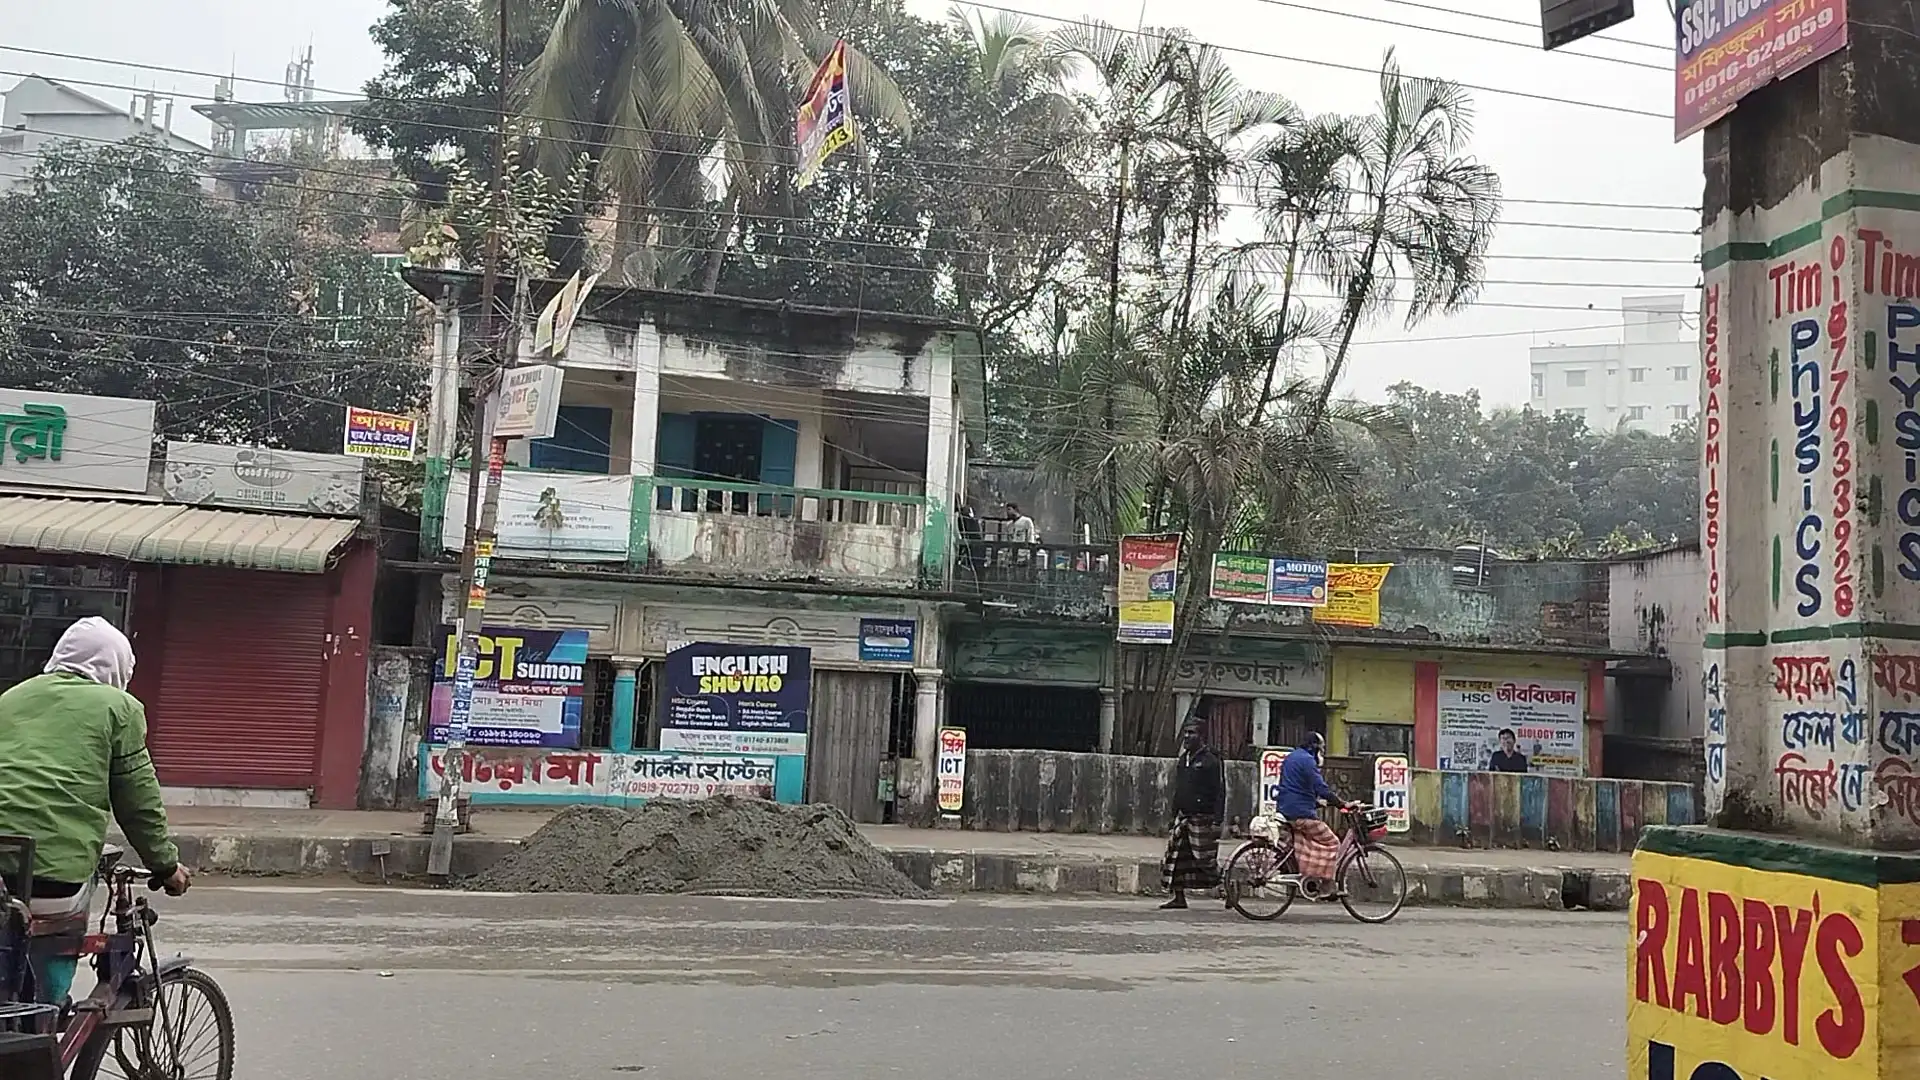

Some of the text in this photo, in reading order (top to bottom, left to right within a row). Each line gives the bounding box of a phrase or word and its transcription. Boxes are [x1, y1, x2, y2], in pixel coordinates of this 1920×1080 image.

[1684, 7, 1834, 105] 01916-624059
[1769, 260, 1822, 320] Tim
[512, 387, 528, 404] ICT
[1286, 562, 1325, 574] MOTION
[444, 635, 524, 680] ICT
[692, 656, 788, 676] ENGLISH
[700, 675, 782, 693] SHUVRO
[1461, 693, 1492, 704] HSC
[1496, 682, 1576, 705] জীববিজ্ঞান
[1517, 728, 1554, 740] BIOLOGY
[696, 758, 774, 782] হোস্টেল
[940, 757, 963, 774] ICT
[1264, 783, 1280, 801] IC
[1379, 790, 1407, 808] ICT
[1635, 878, 1865, 1060] RABBY'S
